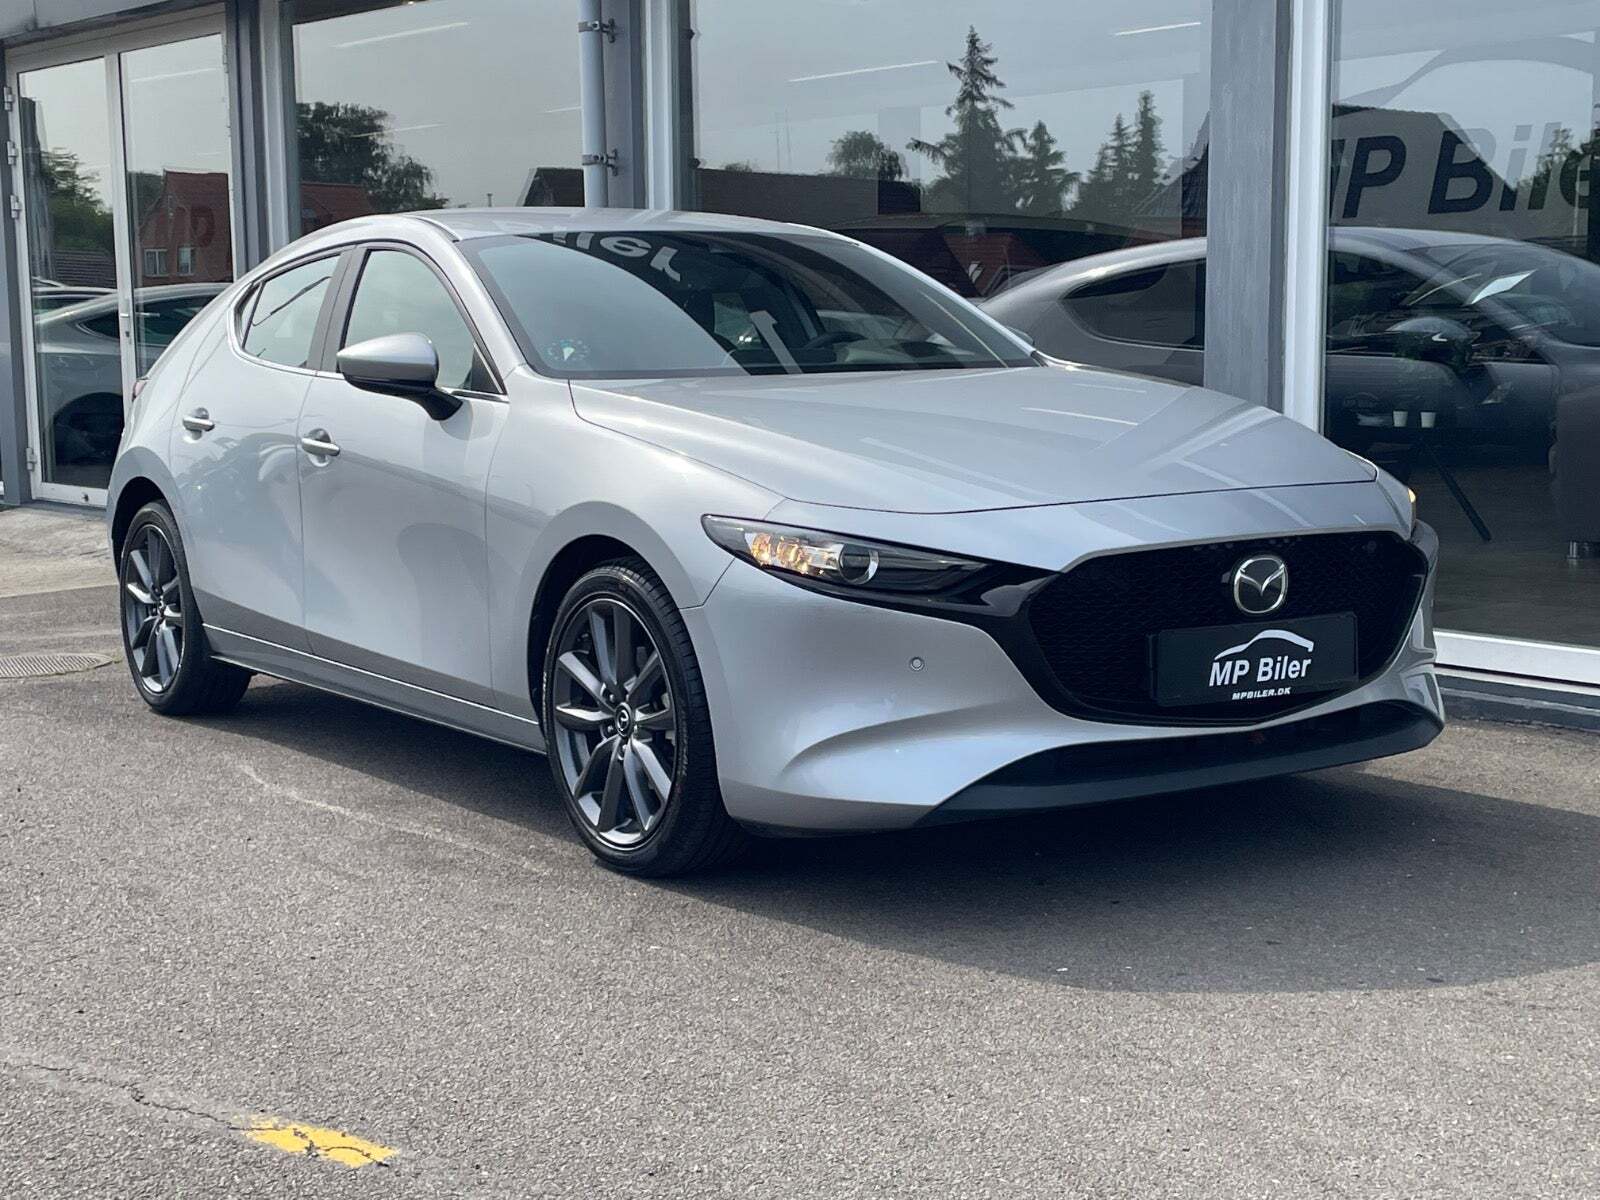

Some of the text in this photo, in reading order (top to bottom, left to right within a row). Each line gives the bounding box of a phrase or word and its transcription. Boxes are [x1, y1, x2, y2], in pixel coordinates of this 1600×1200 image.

[1329, 135, 1407, 219] P
[1209, 655, 1312, 687] MP Biler
[1231, 687, 1291, 700] MPBILER.DK
